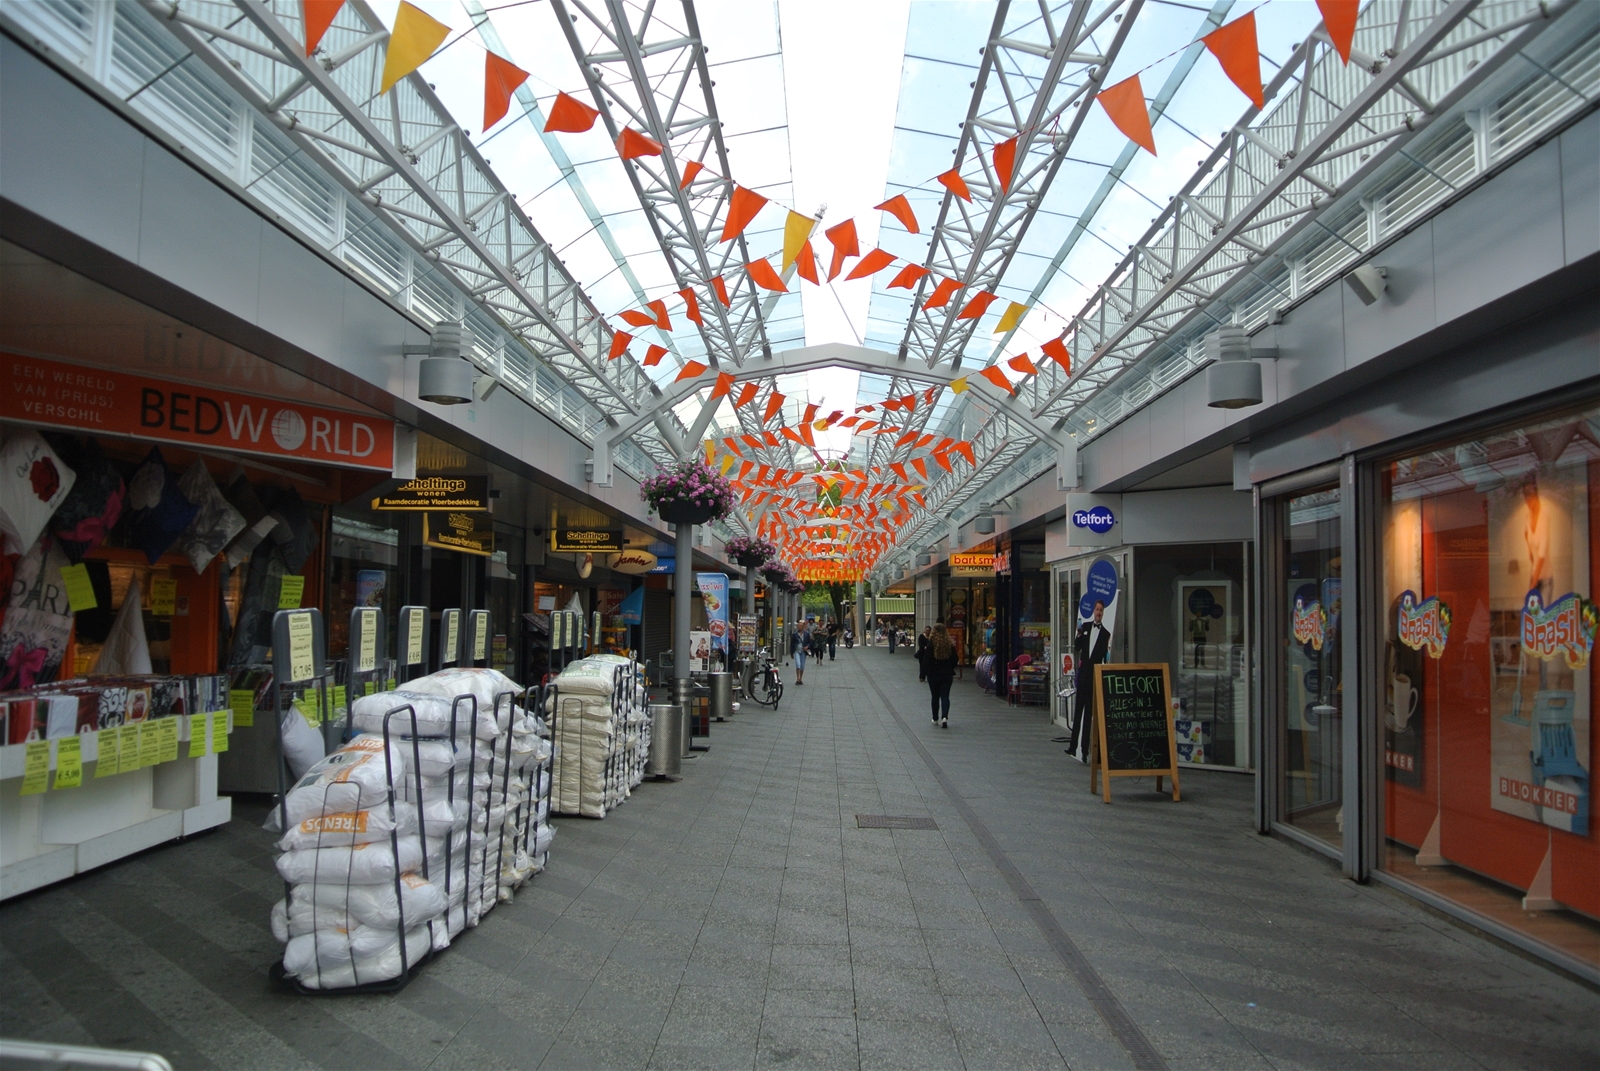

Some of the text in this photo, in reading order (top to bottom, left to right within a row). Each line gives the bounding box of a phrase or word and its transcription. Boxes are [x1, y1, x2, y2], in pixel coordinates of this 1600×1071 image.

[13, 364, 115, 391] EEN WERELD
[13, 382, 114, 408] VAN (PRIJS)
[23, 401, 103, 423] VERSCHIL
[140, 387, 375, 458] BEDWORLD
[383, 498, 480, 507] Raamdecoratie Vloerbedekking
[1075, 513, 1113, 525] Telfort
[566, 531, 610, 541] Scheltinga
[613, 554, 652, 569] jamin
[954, 555, 977, 565] bart
[978, 557, 994, 565] sm
[1103, 675, 1162, 695] TELFORT
[1385, 752, 1414, 771] KKER
[1501, 779, 1577, 812] BLOKKER
[306, 817, 362, 831] TRENDS
